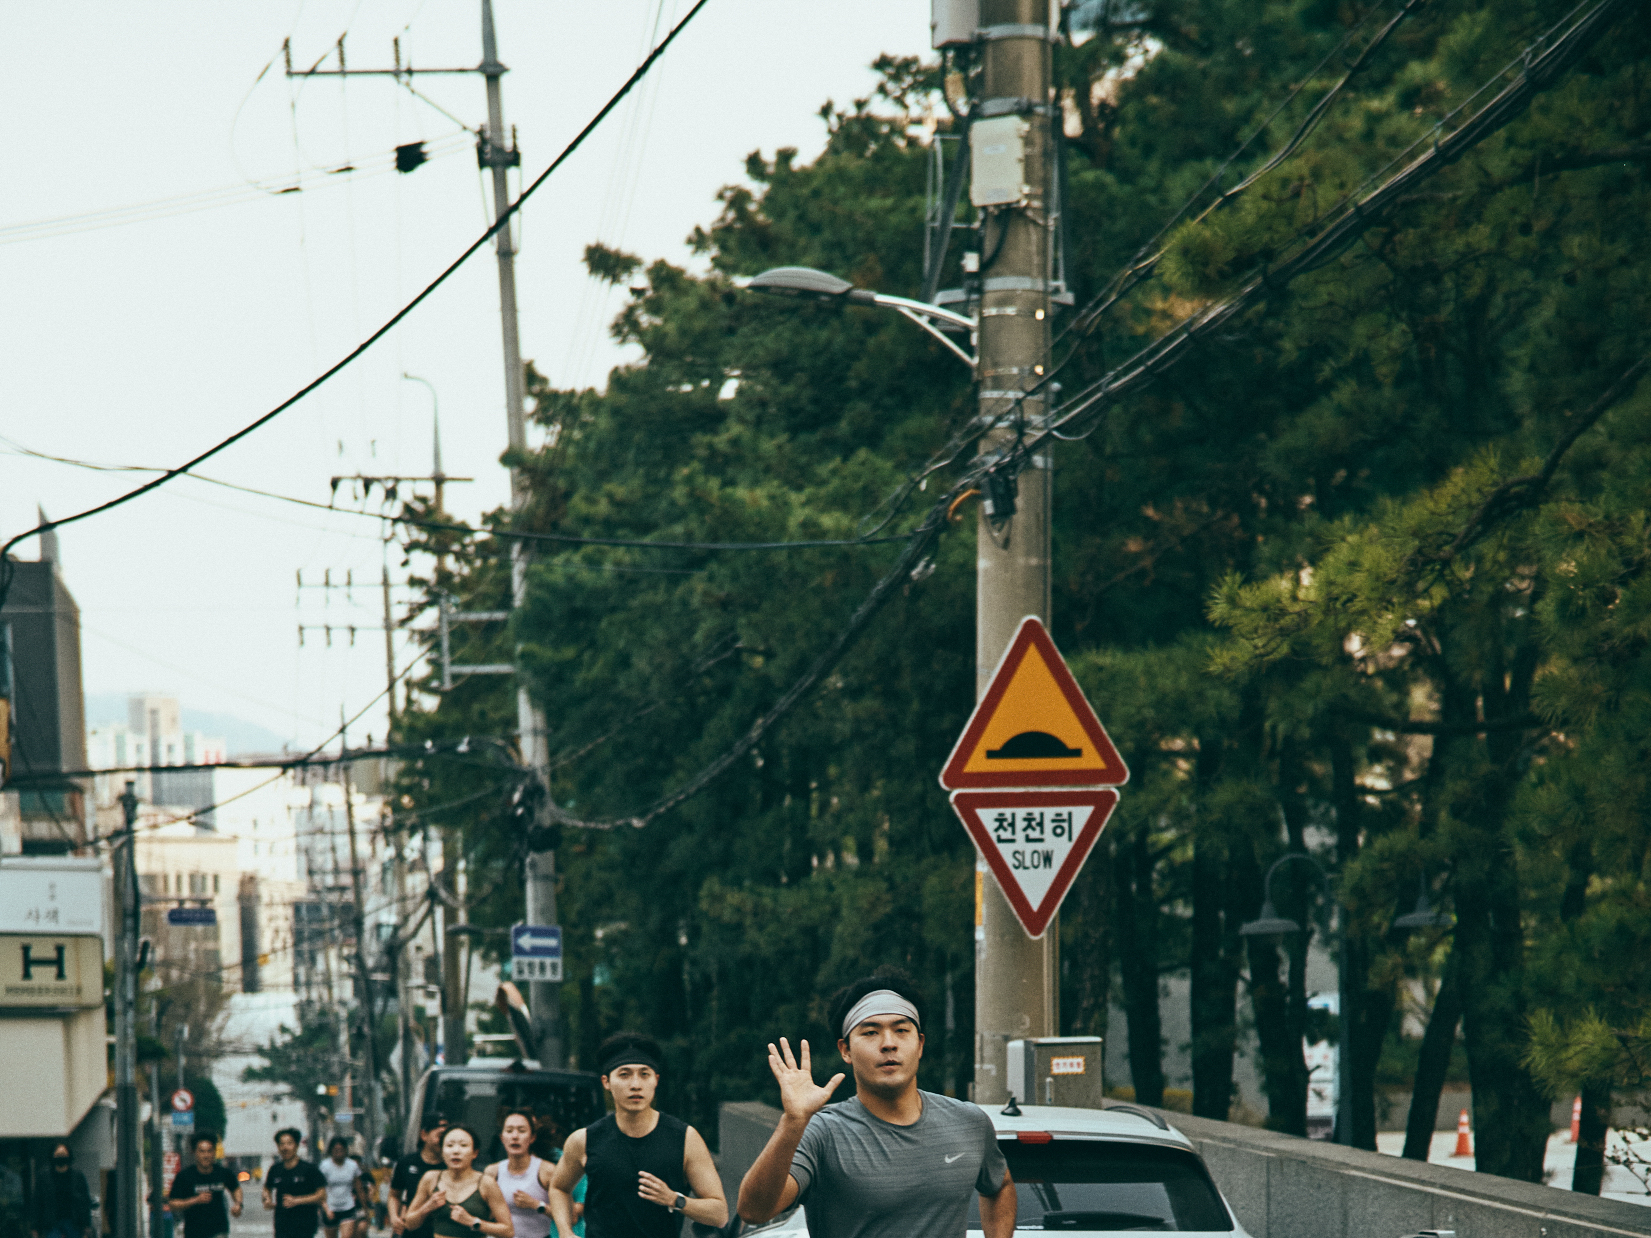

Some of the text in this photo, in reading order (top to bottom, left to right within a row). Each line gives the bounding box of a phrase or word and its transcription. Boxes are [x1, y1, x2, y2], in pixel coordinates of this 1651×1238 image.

[994, 811, 1072, 844] 천천히
[1012, 850, 1054, 870] SLOW
[22, 944, 66, 980] H
